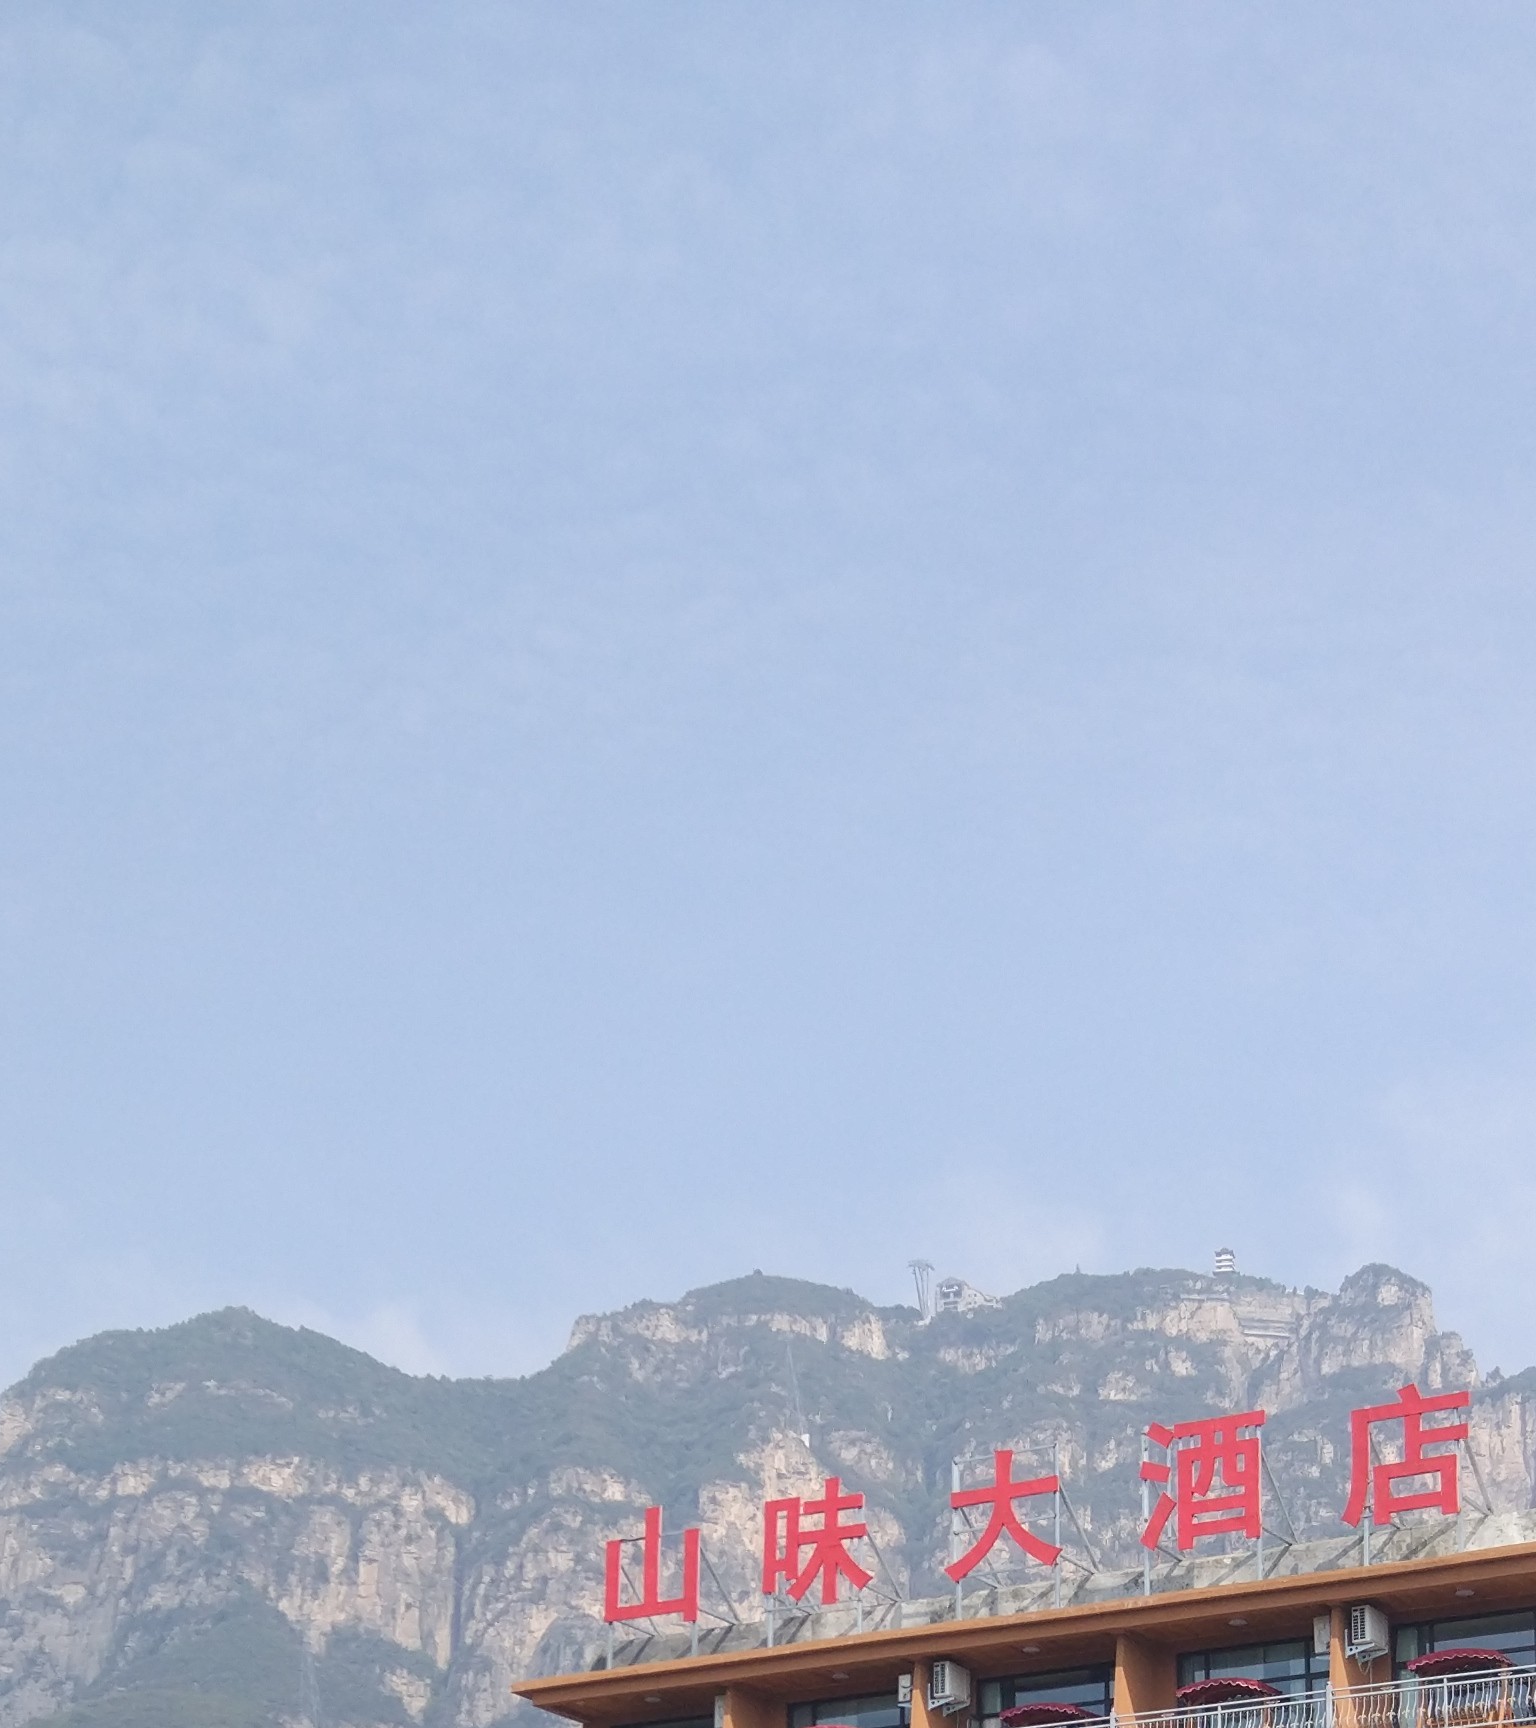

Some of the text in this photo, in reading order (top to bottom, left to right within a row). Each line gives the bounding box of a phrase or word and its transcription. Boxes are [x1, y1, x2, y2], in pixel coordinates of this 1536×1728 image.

[604, 1383, 1470, 1623] 山味大酒店
